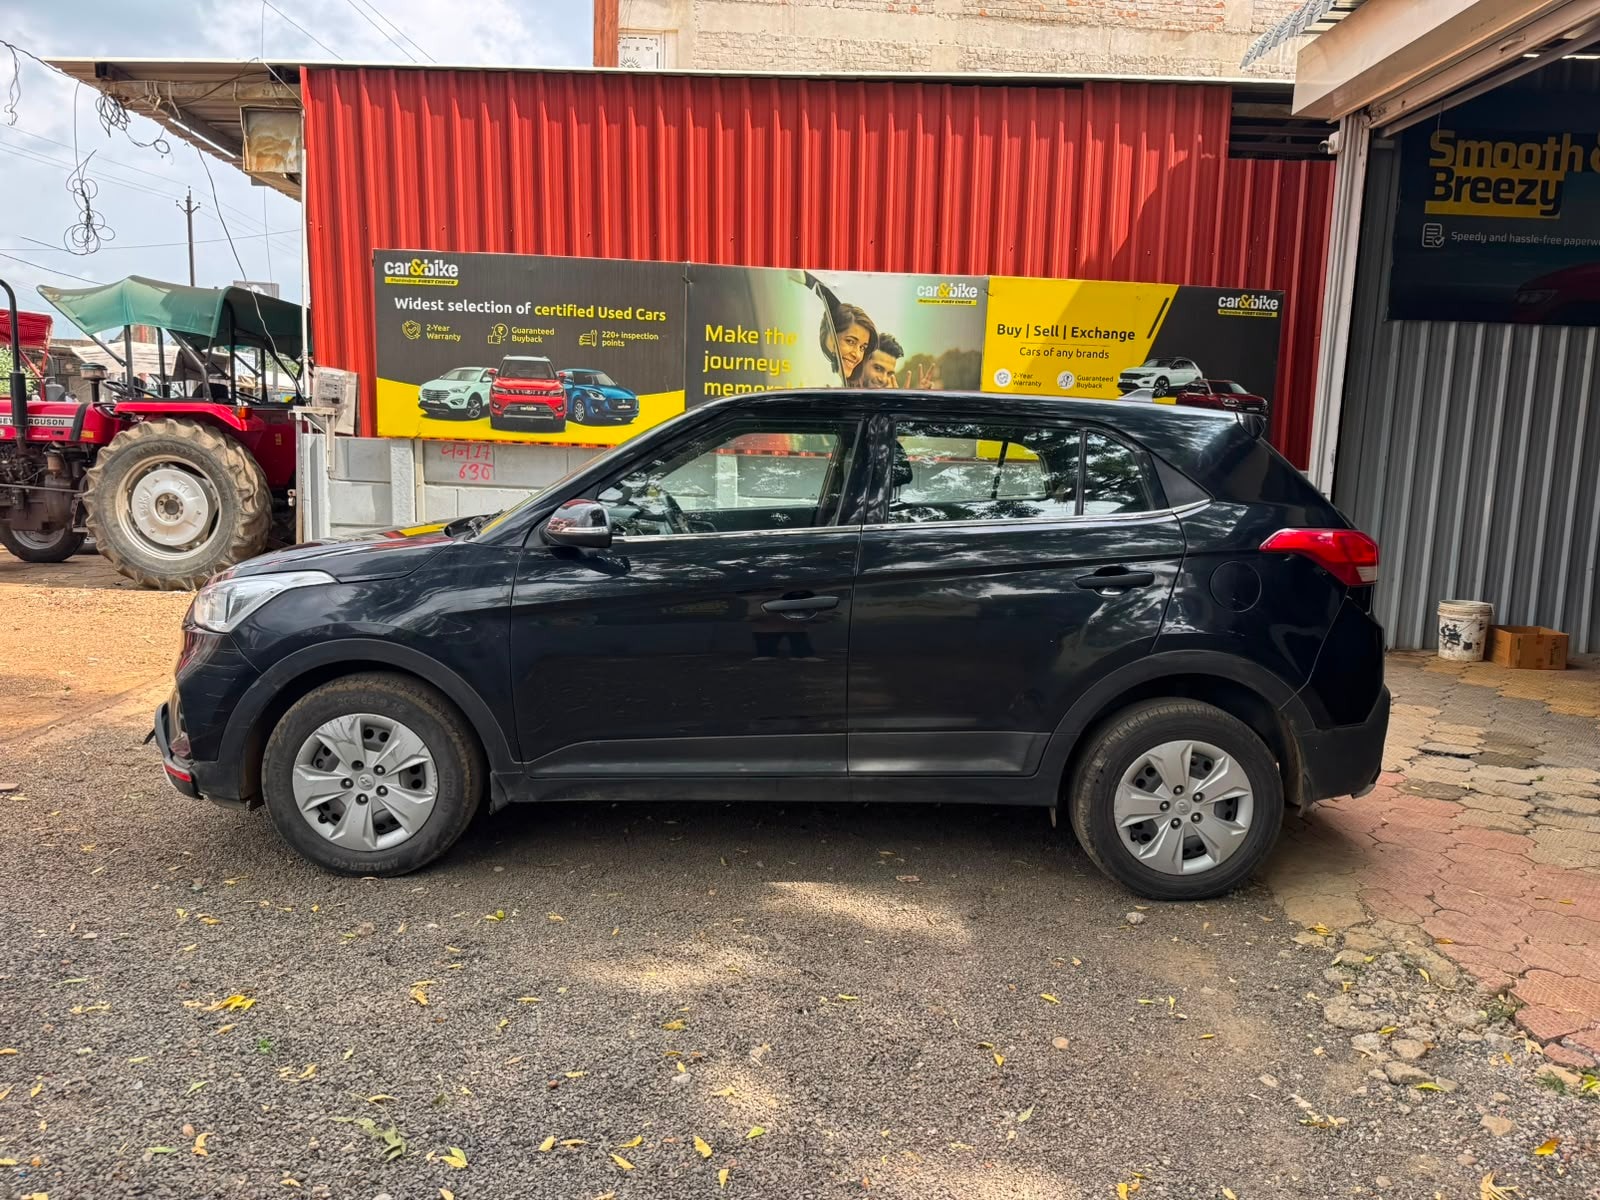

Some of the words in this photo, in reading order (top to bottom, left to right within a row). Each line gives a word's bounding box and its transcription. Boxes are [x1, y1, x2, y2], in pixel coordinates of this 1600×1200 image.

[1429, 130, 1584, 172] Smooth
[1433, 167, 1563, 217] Breezy
[1451, 231, 1487, 244] Speedy
[1489, 233, 1507, 243] and
[1509, 233, 1561, 245] hassle-free
[384, 258, 459, 278] car&bike
[917, 282, 979, 298] car&bike
[394, 297, 444, 312] Widest
[448, 299, 512, 314] selection
[516, 301, 531, 315] of
[534, 303, 594, 318] certified
[598, 306, 632, 320] Used
[636, 308, 667, 322] Cars
[1218, 294, 1279, 311] car&bike
[426, 324, 450, 332] 2-Year
[511, 326, 555, 336] Guaranteed
[705, 324, 759, 344] Make
[765, 327, 798, 346] the
[997, 323, 1022, 338] Buy
[1034, 325, 1059, 337] Sell
[1071, 326, 1136, 343] Exchange
[426, 332, 461, 342] Warranty
[511, 335, 543, 343] Buyback
[602, 331, 620, 339] 220+
[621, 332, 659, 342] inspection
[602, 339, 625, 347] points
[1019, 346, 1041, 357] Cars
[1043, 347, 1055, 357] of
[1056, 349, 1074, 360] any
[1076, 349, 1110, 360] brands
[703, 350, 792, 376] journeys
[1013, 380, 1042, 388] Warranty
[1077, 375, 1114, 383] Guaranteed
[1077, 382, 1103, 390] Buyback
[704, 381, 804, 396] memo
[29, 418, 65, 426] RGUSON
[459, 463, 490, 481] 630
